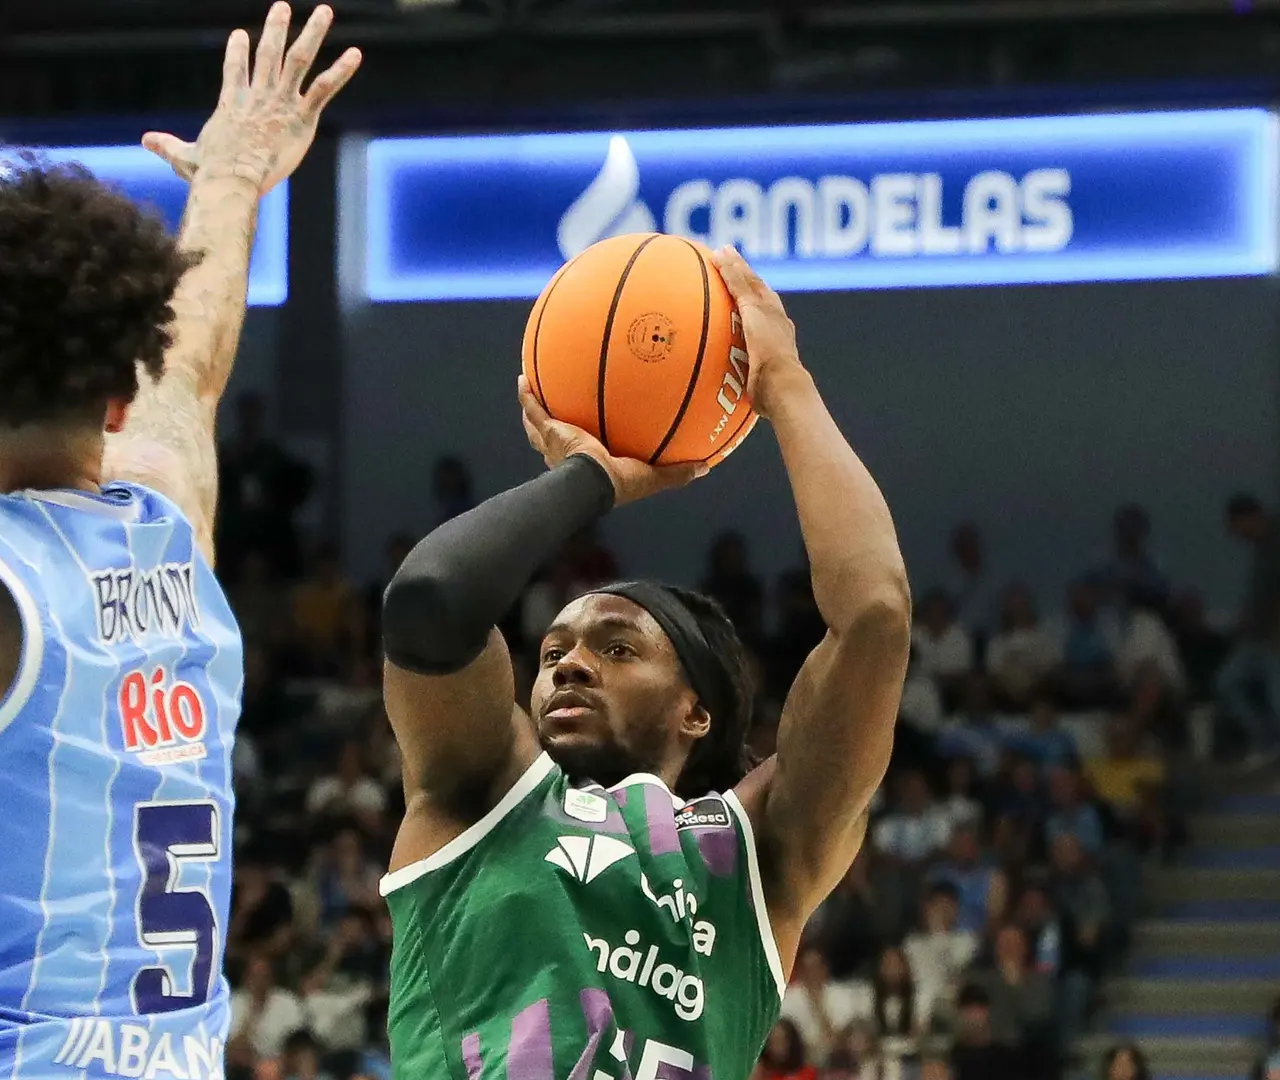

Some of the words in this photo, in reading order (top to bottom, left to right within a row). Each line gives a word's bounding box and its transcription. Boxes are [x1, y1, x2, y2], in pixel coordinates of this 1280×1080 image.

[664, 168, 1073, 258] CANDELAS
[119, 666, 205, 750] Río
[132, 801, 219, 1015] 5
